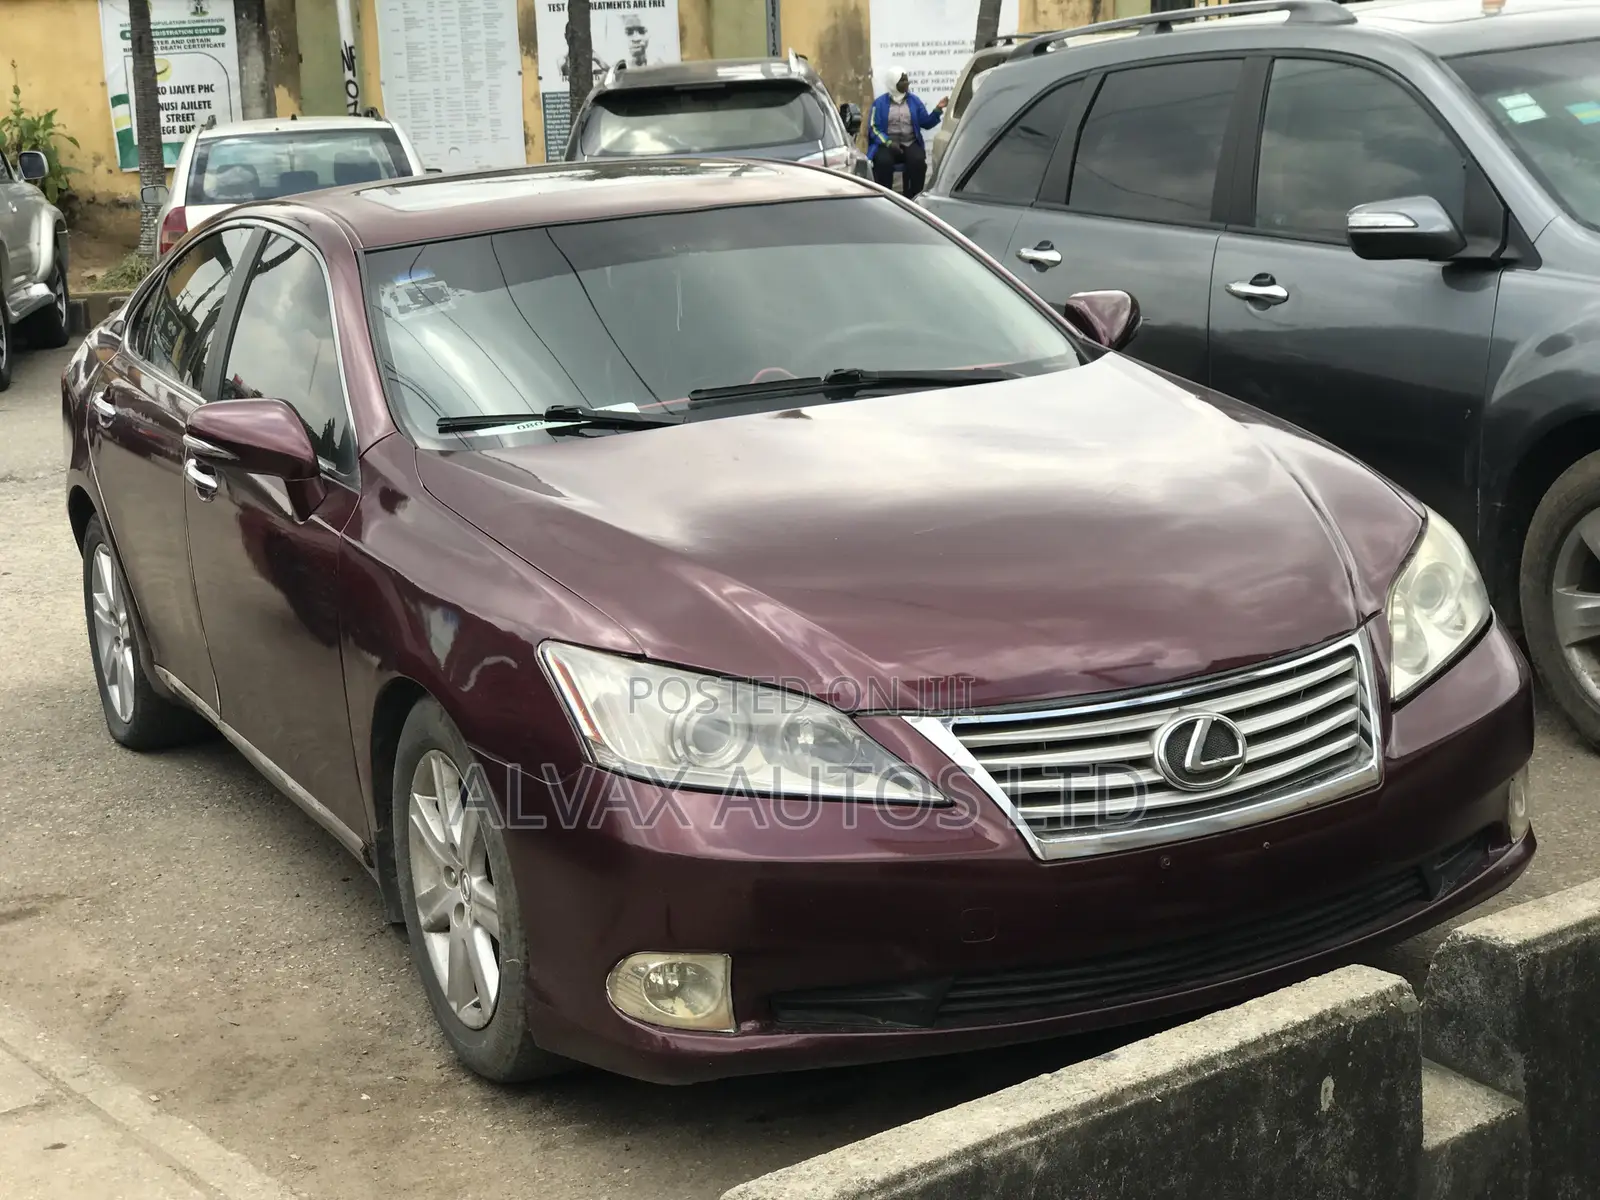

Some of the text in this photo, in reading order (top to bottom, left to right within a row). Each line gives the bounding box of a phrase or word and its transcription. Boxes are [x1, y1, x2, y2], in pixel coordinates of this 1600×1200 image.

[548, 0, 665, 12] TEST REATMENTS ARE FREE
[184, 42, 226, 50] CERTIFICATE
[169, 84, 196, 95] IJAIYE
[198, 83, 215, 93] PHC
[181, 100, 212, 110] AJILETE
[166, 113, 195, 123] STREET
